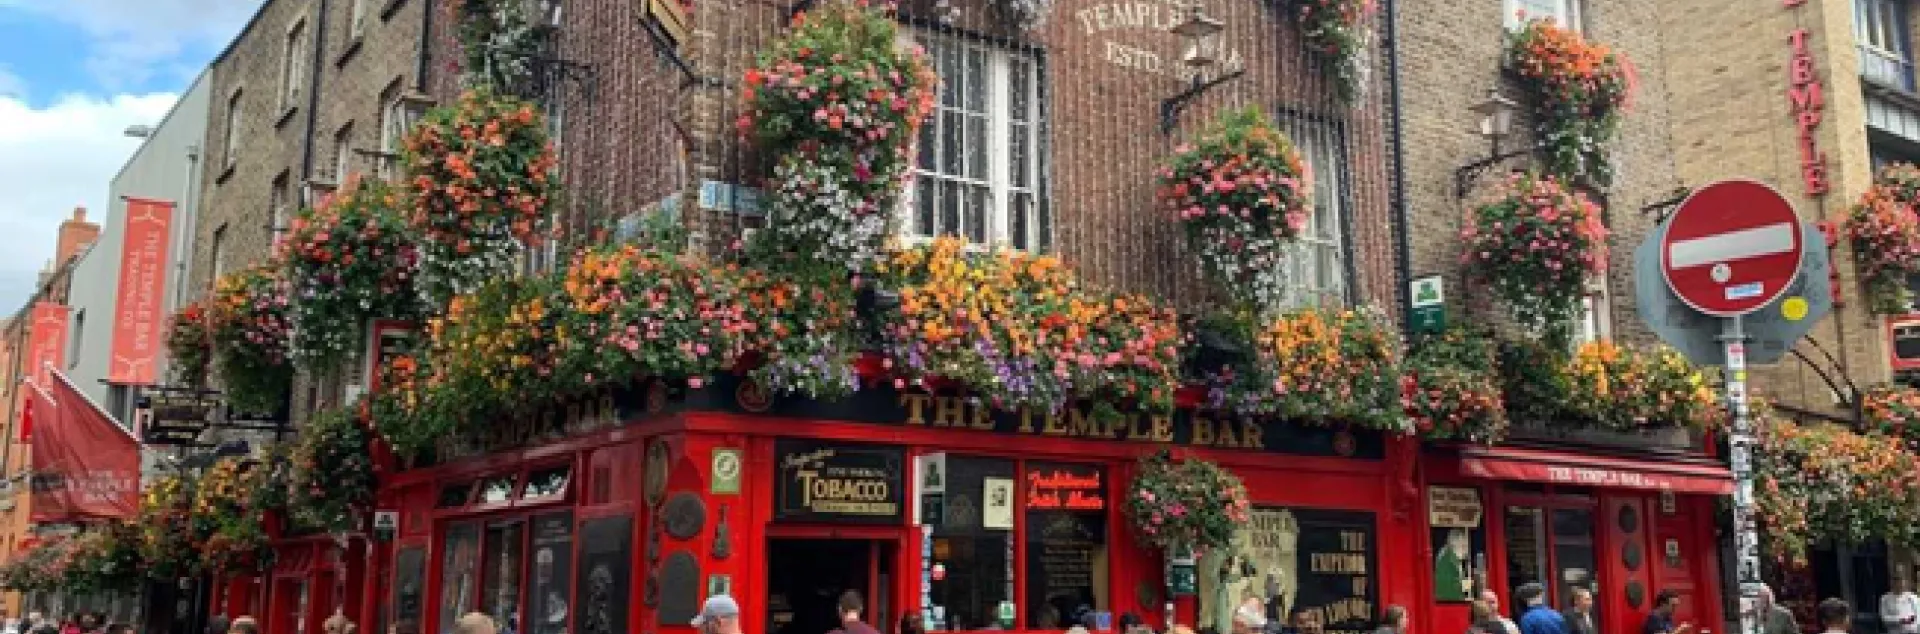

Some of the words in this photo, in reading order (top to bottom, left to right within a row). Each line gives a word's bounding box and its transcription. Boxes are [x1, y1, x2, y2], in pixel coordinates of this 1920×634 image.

[1788, 29, 1829, 194] TEMPLE
[900, 393, 995, 430] THE
[1191, 416, 1264, 449] BAR
